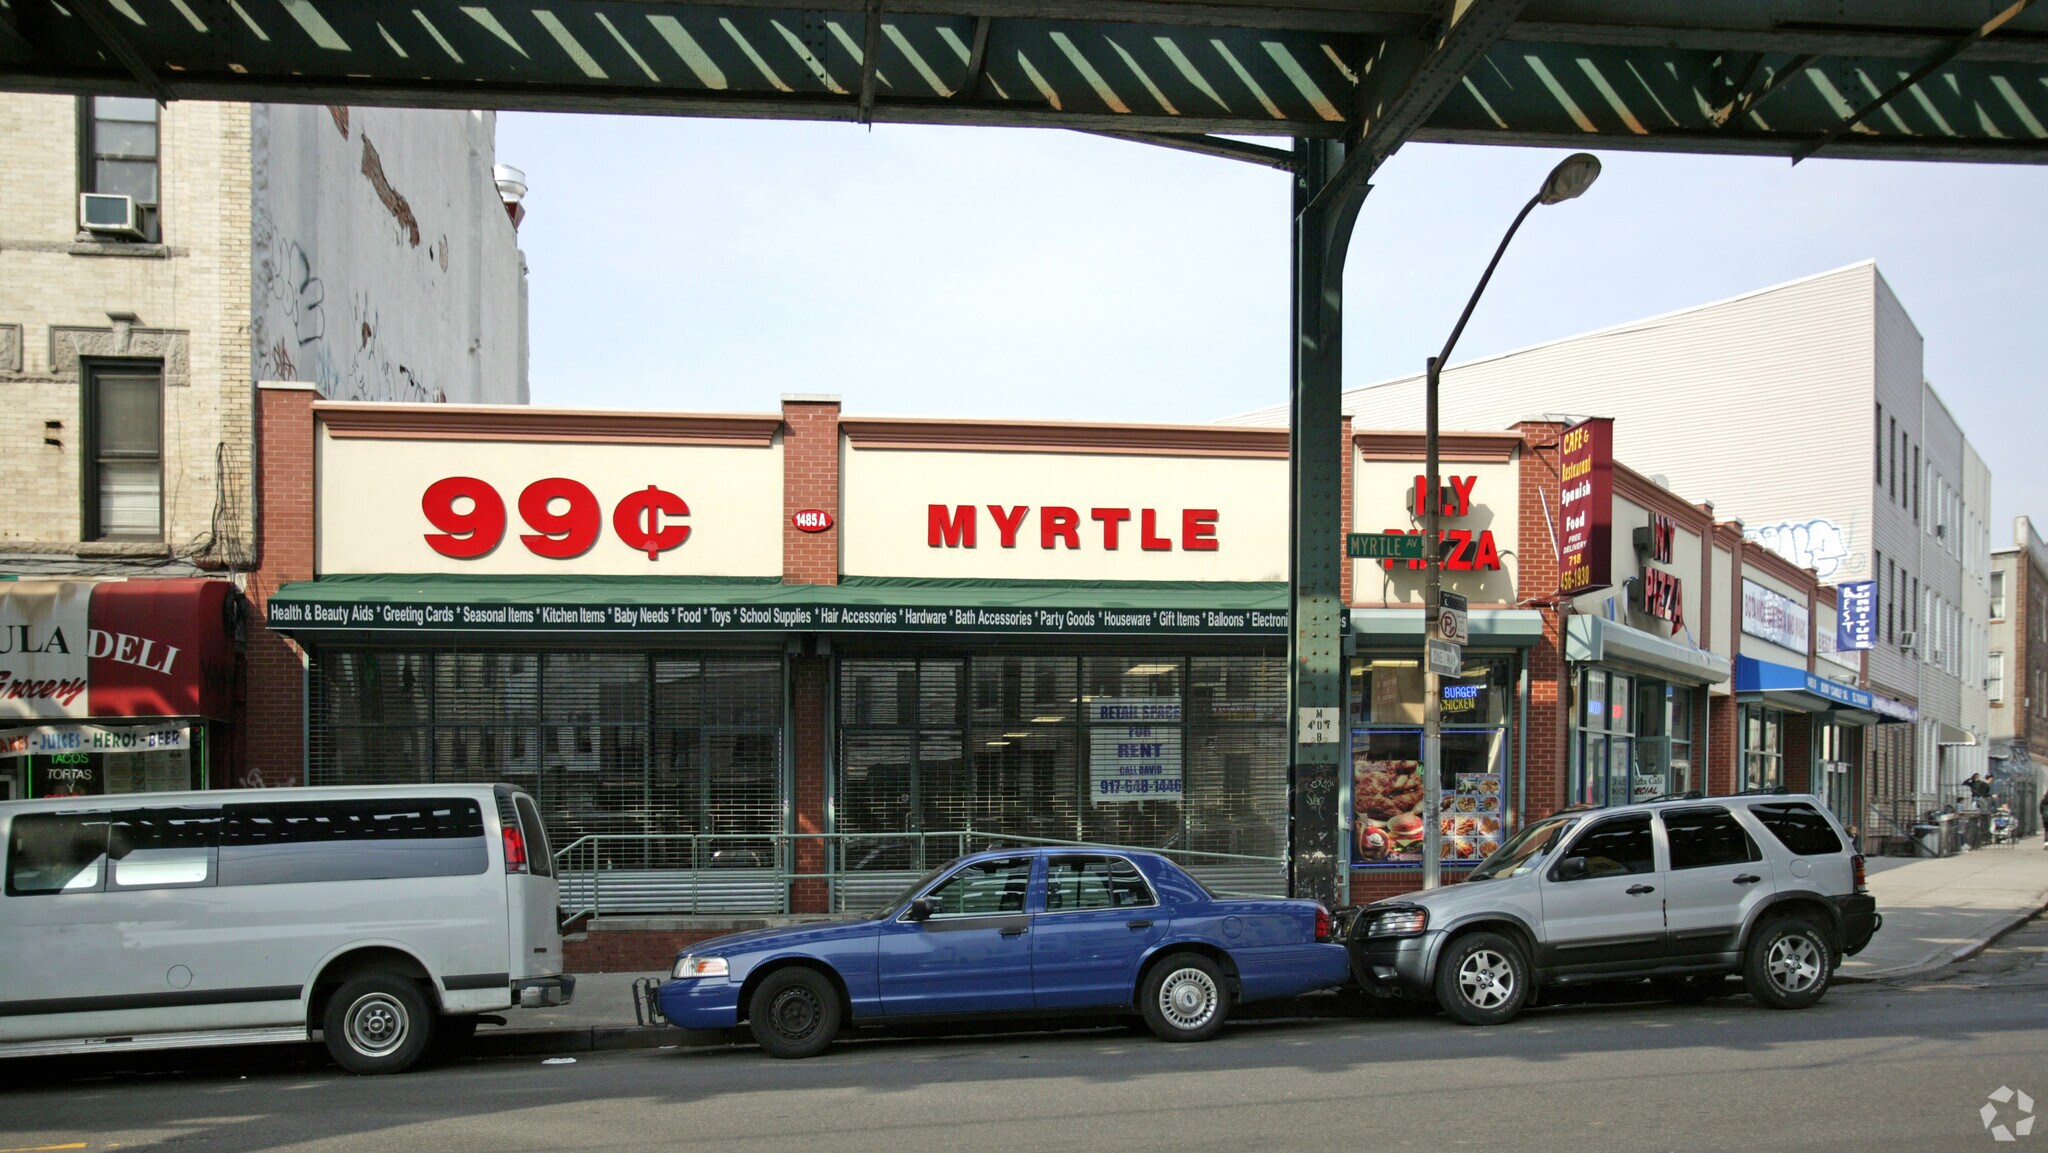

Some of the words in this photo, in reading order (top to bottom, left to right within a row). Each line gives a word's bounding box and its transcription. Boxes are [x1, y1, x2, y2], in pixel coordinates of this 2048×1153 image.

[1563, 428, 1583, 455] CAFE
[1561, 454, 1592, 483] Restaurant
[1561, 480, 1591, 507] Spanish
[796, 513, 818, 527] 1485
[928, 504, 1220, 551] MYRTLE
[1565, 511, 1586, 532] Food
[1568, 532, 1582, 543] FREE
[1351, 537, 1401, 556] MYRTLE
[1406, 538, 1418, 548] AV
[1563, 540, 1587, 555] DELIVERY
[1568, 553, 1582, 566] 718
[1645, 564, 1683, 624] PIZZA
[270, 604, 302, 621] Health
[304, 605, 313, 621] &
[315, 605, 349, 626] Beauty
[352, 605, 374, 622] Aids
[383, 605, 424, 626] Greeting
[426, 606, 454, 622] Cards
[463, 606, 506, 623] Seasonal
[508, 607, 534, 623] Items
[542, 607, 577, 624] Kitchen
[580, 607, 605, 624] Items
[614, 607, 638, 627] Baby
[640, 607, 669, 624] Needs
[677, 607, 702, 624] Food
[710, 608, 731, 627] Toys
[740, 608, 771, 624] School
[773, 608, 811, 628] Supplies
[820, 608, 838, 624] Hair
[841, 608, 897, 624] Accessories
[905, 609, 947, 625] Hardware
[955, 609, 976, 625] Bath
[978, 610, 1032, 626] Accessories
[1040, 611, 1065, 630] Party
[1066, 611, 1095, 627] Goods
[1104, 611, 1151, 628] Houseware
[1158, 611, 1175, 628] Gift
[1176, 612, 1200, 628] Items
[1208, 612, 1244, 628] Balloons
[87, 628, 182, 676] DELI
[1444, 685, 1478, 699] BURGER
[1440, 697, 1476, 711] CHICKEN
[1307, 719, 1331, 731] 407
[40, 732, 81, 750] JUICES
[93, 731, 137, 749] HEROS
[148, 729, 180, 747] BEER
[50, 752, 89, 764] TACOS
[1118, 743, 1163, 758] RENT
[47, 768, 92, 780] TORTAS
[66, 783, 75, 793] Y
